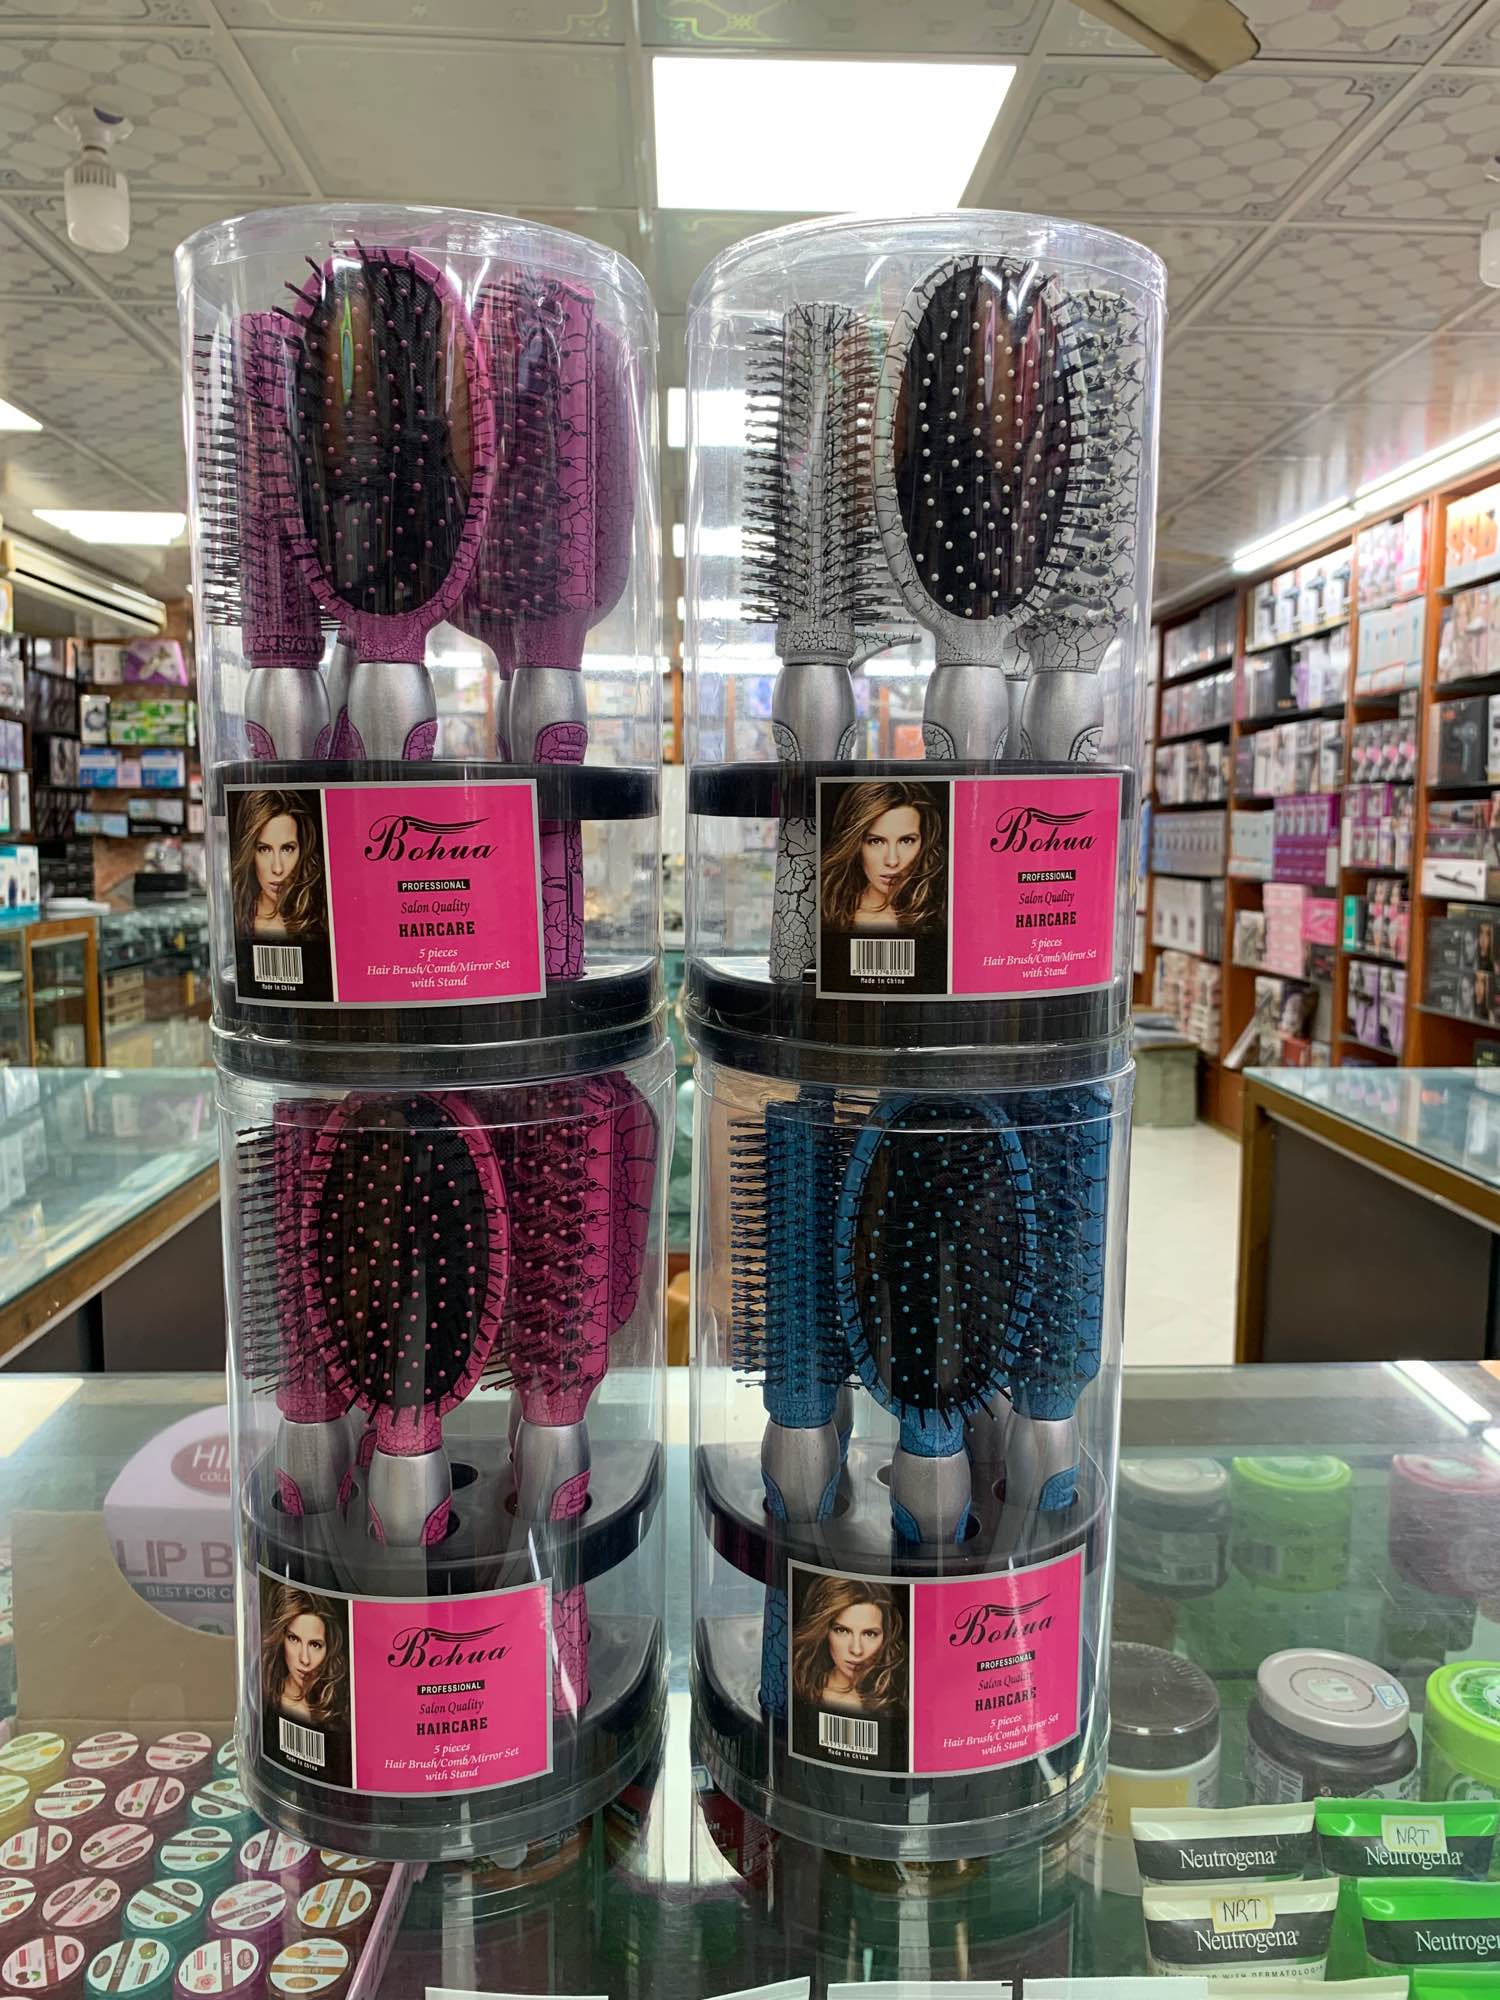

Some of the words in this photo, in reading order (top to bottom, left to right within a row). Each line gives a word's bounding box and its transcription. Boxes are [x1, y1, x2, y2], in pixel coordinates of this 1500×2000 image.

[364, 815, 498, 861] Bohua
[990, 807, 1098, 853] Bohua
[401, 880, 467, 891] PROFESSIONAL
[1021, 872, 1073, 882] PROFESSIONAL
[1018, 892, 1044, 905] Salon
[1044, 890, 1075, 907] Quality
[400, 900, 430, 914] Salon
[431, 899, 471, 916] Quality
[1015, 911, 1077, 928] HAIRCARE
[399, 921, 476, 938] HAIRCARE
[1031, 938, 1038, 949] 5
[1038, 937, 1063, 951] pieces
[418, 948, 426, 959] 5
[427, 947, 458, 961] pieces
[983, 955, 1005, 967] Hair
[1006, 950, 1085, 966] Brush/Comb/Mirror
[1086, 949, 1097, 960] Set
[367, 964, 390, 976] Hair
[392, 960, 493, 975] Brush/Comb/Mirror
[495, 959, 511, 970] Set
[1022, 966, 1042, 979] with
[1044, 965, 1067, 977] Stand
[411, 977, 435, 989] with
[437, 975, 468, 987] Stand
[116, 1538, 188, 1577] LIP
[146, 1585, 183, 1598] BEST
[186, 1586, 217, 1599] FOR
[949, 1594, 1055, 1647] Bohua
[387, 1622, 512, 1668] Bohua
[980, 1653, 1033, 1670] PROFESSIONAL
[421, 1682, 482, 1694] PROFESSIONAL
[978, 1677, 1003, 1691] Salon
[419, 1703, 446, 1715] Salon
[447, 1699, 484, 1714] Quality
[975, 1686, 1037, 1712] HAIRCARE
[416, 1716, 488, 1736] HAIRCARE
[990, 1718, 997, 1728] 5
[998, 1713, 1023, 1727] pieces
[943, 1736, 965, 1749] Hair
[1047, 1712, 1060, 1724] Set
[434, 1745, 440, 1754] 5
[442, 1742, 471, 1756] pieces
[981, 1744, 1003, 1757] with
[1003, 1738, 1029, 1754] Stand
[384, 1758, 407, 1769] Hair
[408, 1751, 504, 1769] Brush/Comb/Mirror
[505, 1746, 520, 1757] Set
[425, 1771, 448, 1781] with
[450, 1767, 478, 1780] Stand
[1396, 1826, 1430, 1847] NRT
[1179, 1848, 1276, 1871] Neutrogena
[1222, 1898, 1262, 1922] NRT
[1194, 1930, 1298, 1953] Neutrogena
